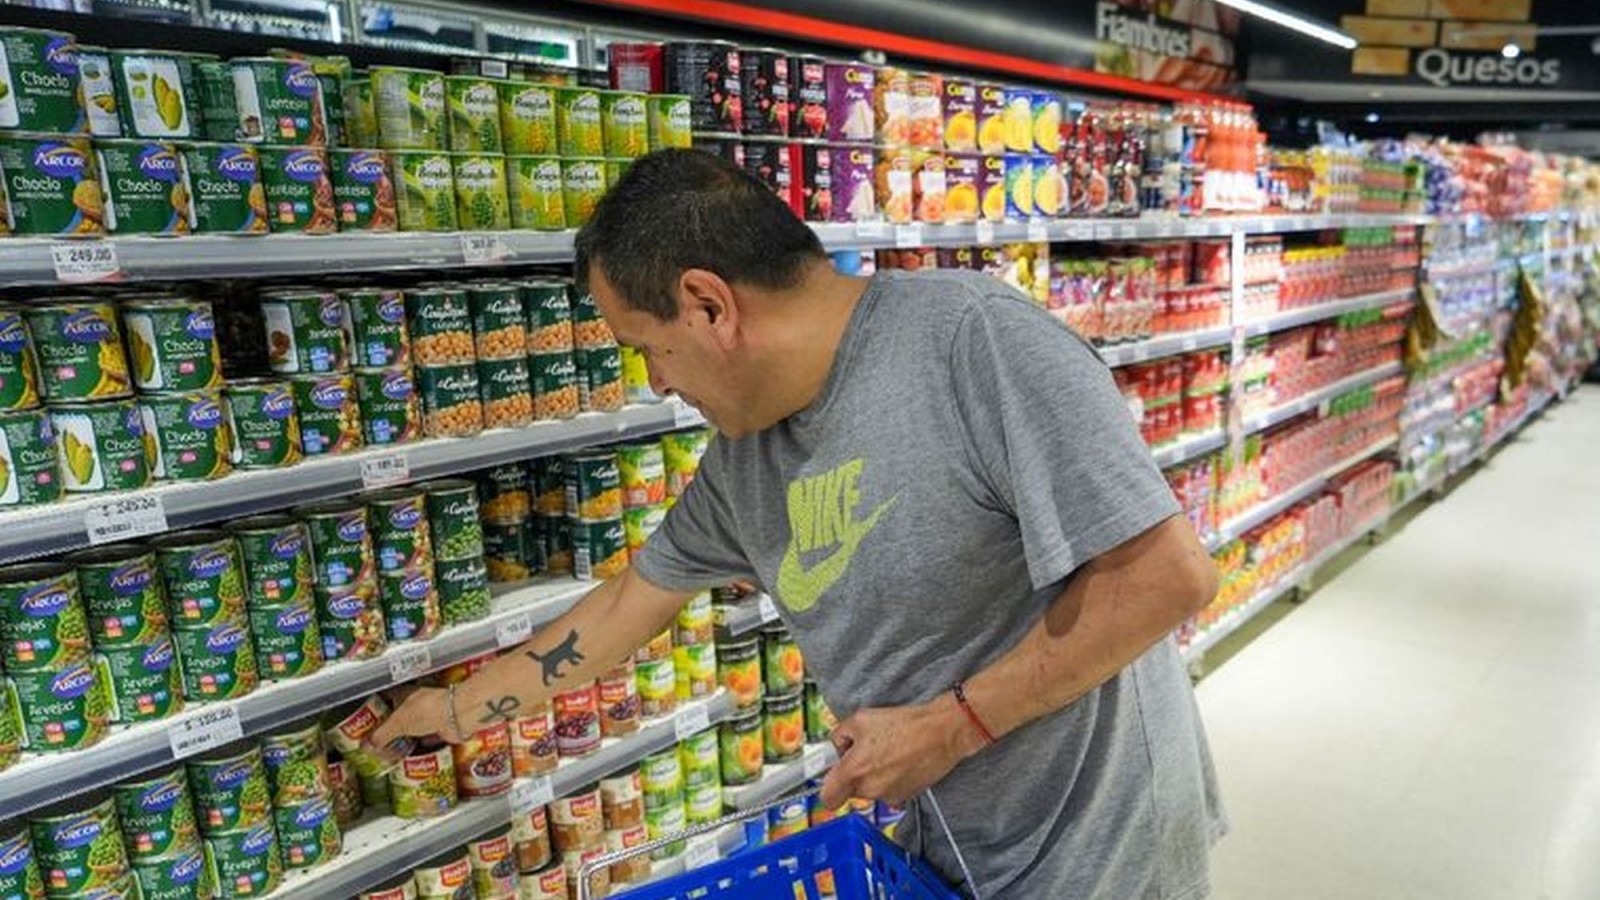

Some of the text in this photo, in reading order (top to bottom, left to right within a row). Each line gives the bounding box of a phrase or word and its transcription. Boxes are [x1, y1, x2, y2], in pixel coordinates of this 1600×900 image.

[1096, 1, 1189, 58] Fiambres
[1416, 48, 1560, 86] Quesos
[21, 71, 69, 88] Choclo
[34, 152, 86, 168] ARCOR
[13, 176, 61, 191] Choclo
[117, 178, 162, 193] Choclo
[198, 178, 240, 194] Choclo
[334, 186, 371, 197] entejas
[41, 343, 87, 357] Choclo
[163, 339, 205, 352] Choclo
[241, 419, 280, 431] Choclo
[165, 428, 207, 443] Choclo
[787, 457, 864, 553] NIKE
[21, 593, 69, 609] ARCOR
